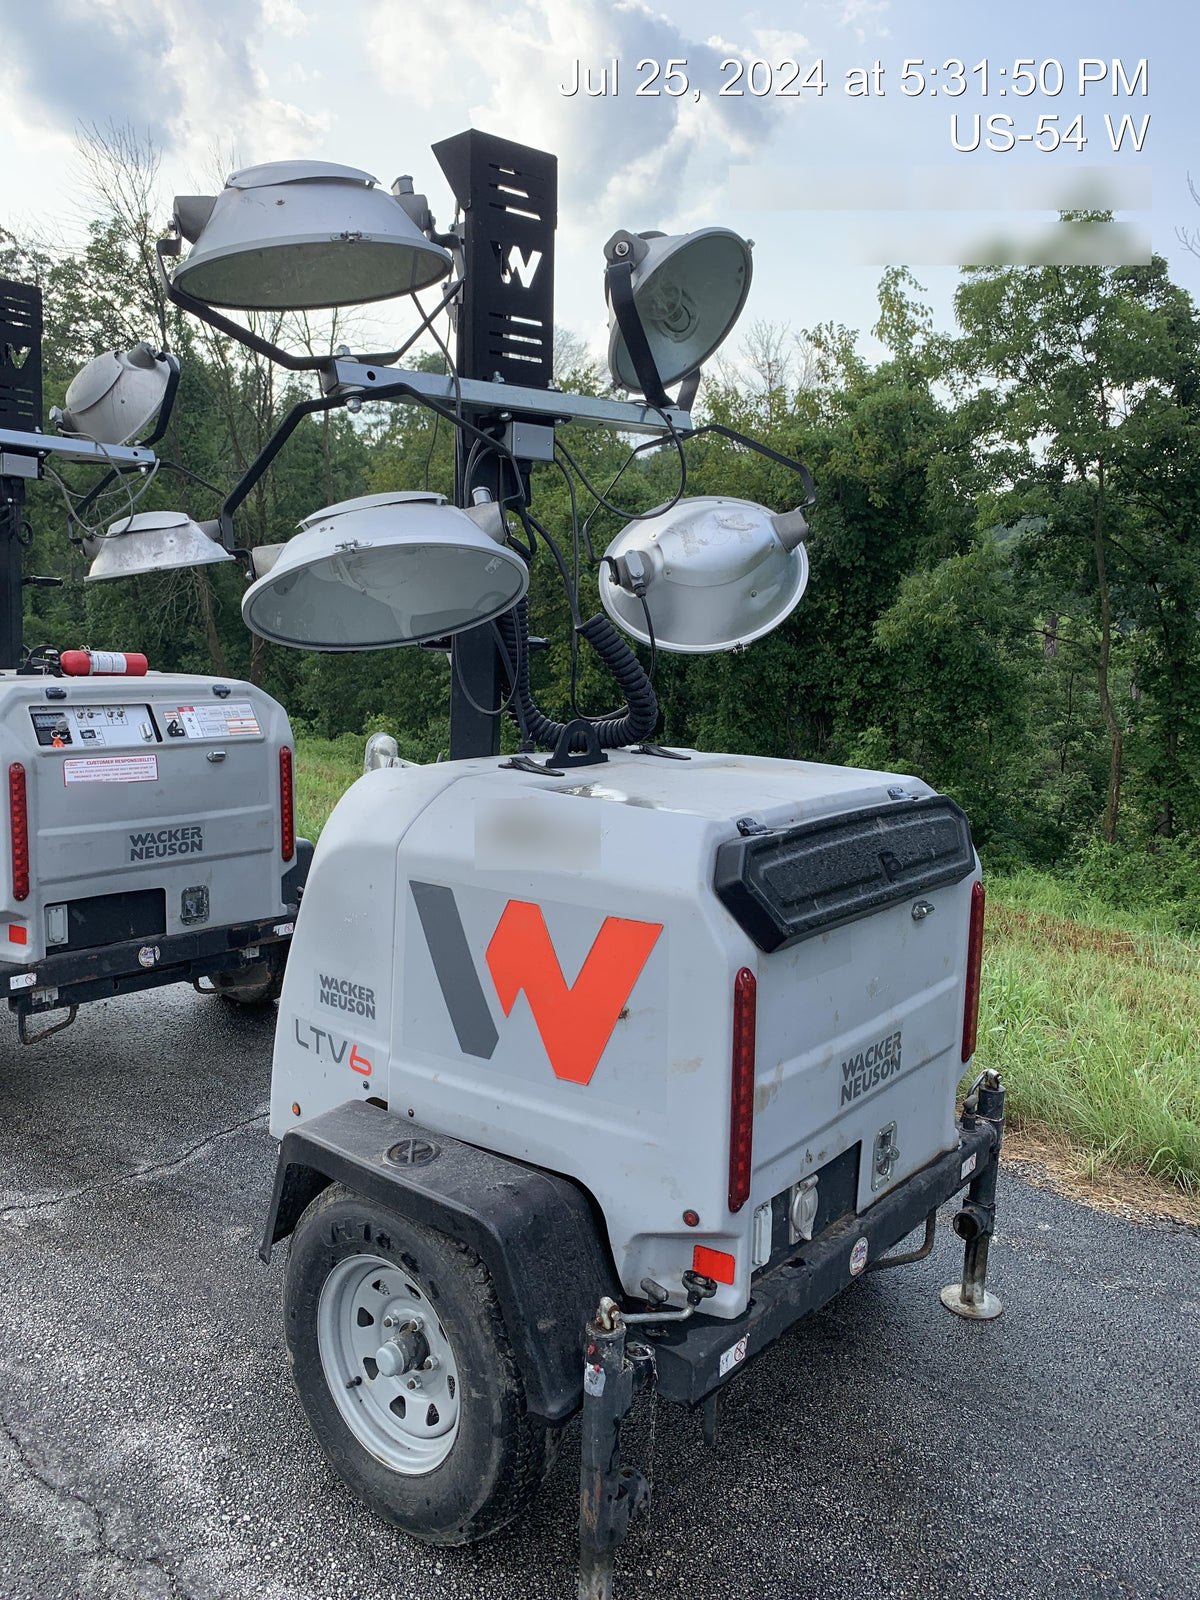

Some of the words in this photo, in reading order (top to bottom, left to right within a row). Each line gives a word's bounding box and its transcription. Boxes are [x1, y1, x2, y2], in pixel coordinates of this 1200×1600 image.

[129, 826, 203, 848] WACKER
[130, 839, 203, 861] NEUSON
[319, 973, 376, 1005] WACKER
[409, 879, 664, 1086] W
[319, 989, 376, 1020] NEUSON
[295, 1018, 373, 1077] LTV6
[842, 1030, 902, 1082] WACKER
[840, 1051, 902, 1107] NEUSON
